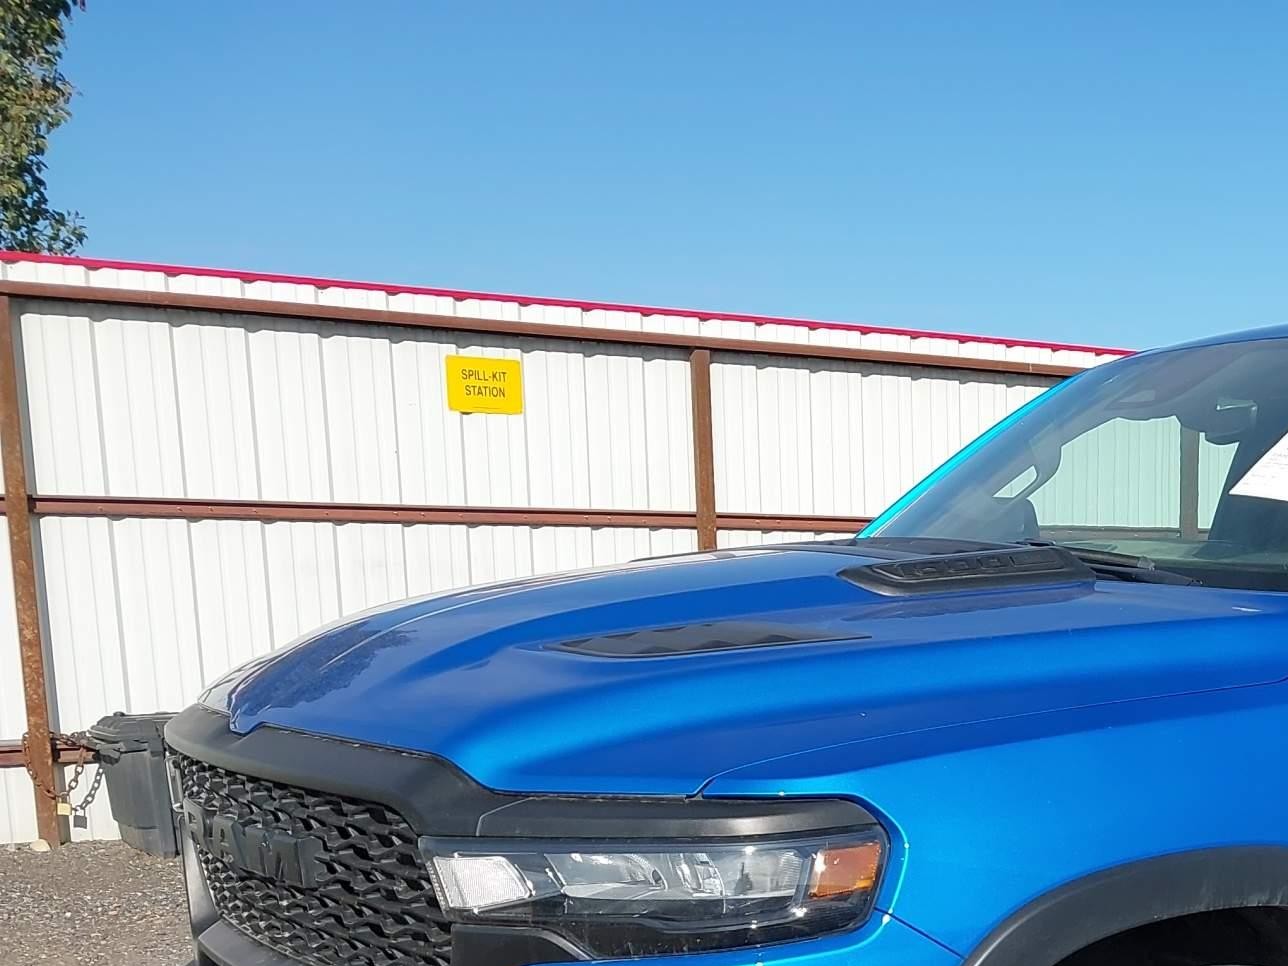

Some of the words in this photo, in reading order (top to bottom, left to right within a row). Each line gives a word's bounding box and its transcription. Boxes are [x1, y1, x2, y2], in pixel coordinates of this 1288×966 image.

[461, 369, 507, 382] SPILL-KIT
[464, 385, 506, 398] STATION
[183, 798, 327, 889] RAM
